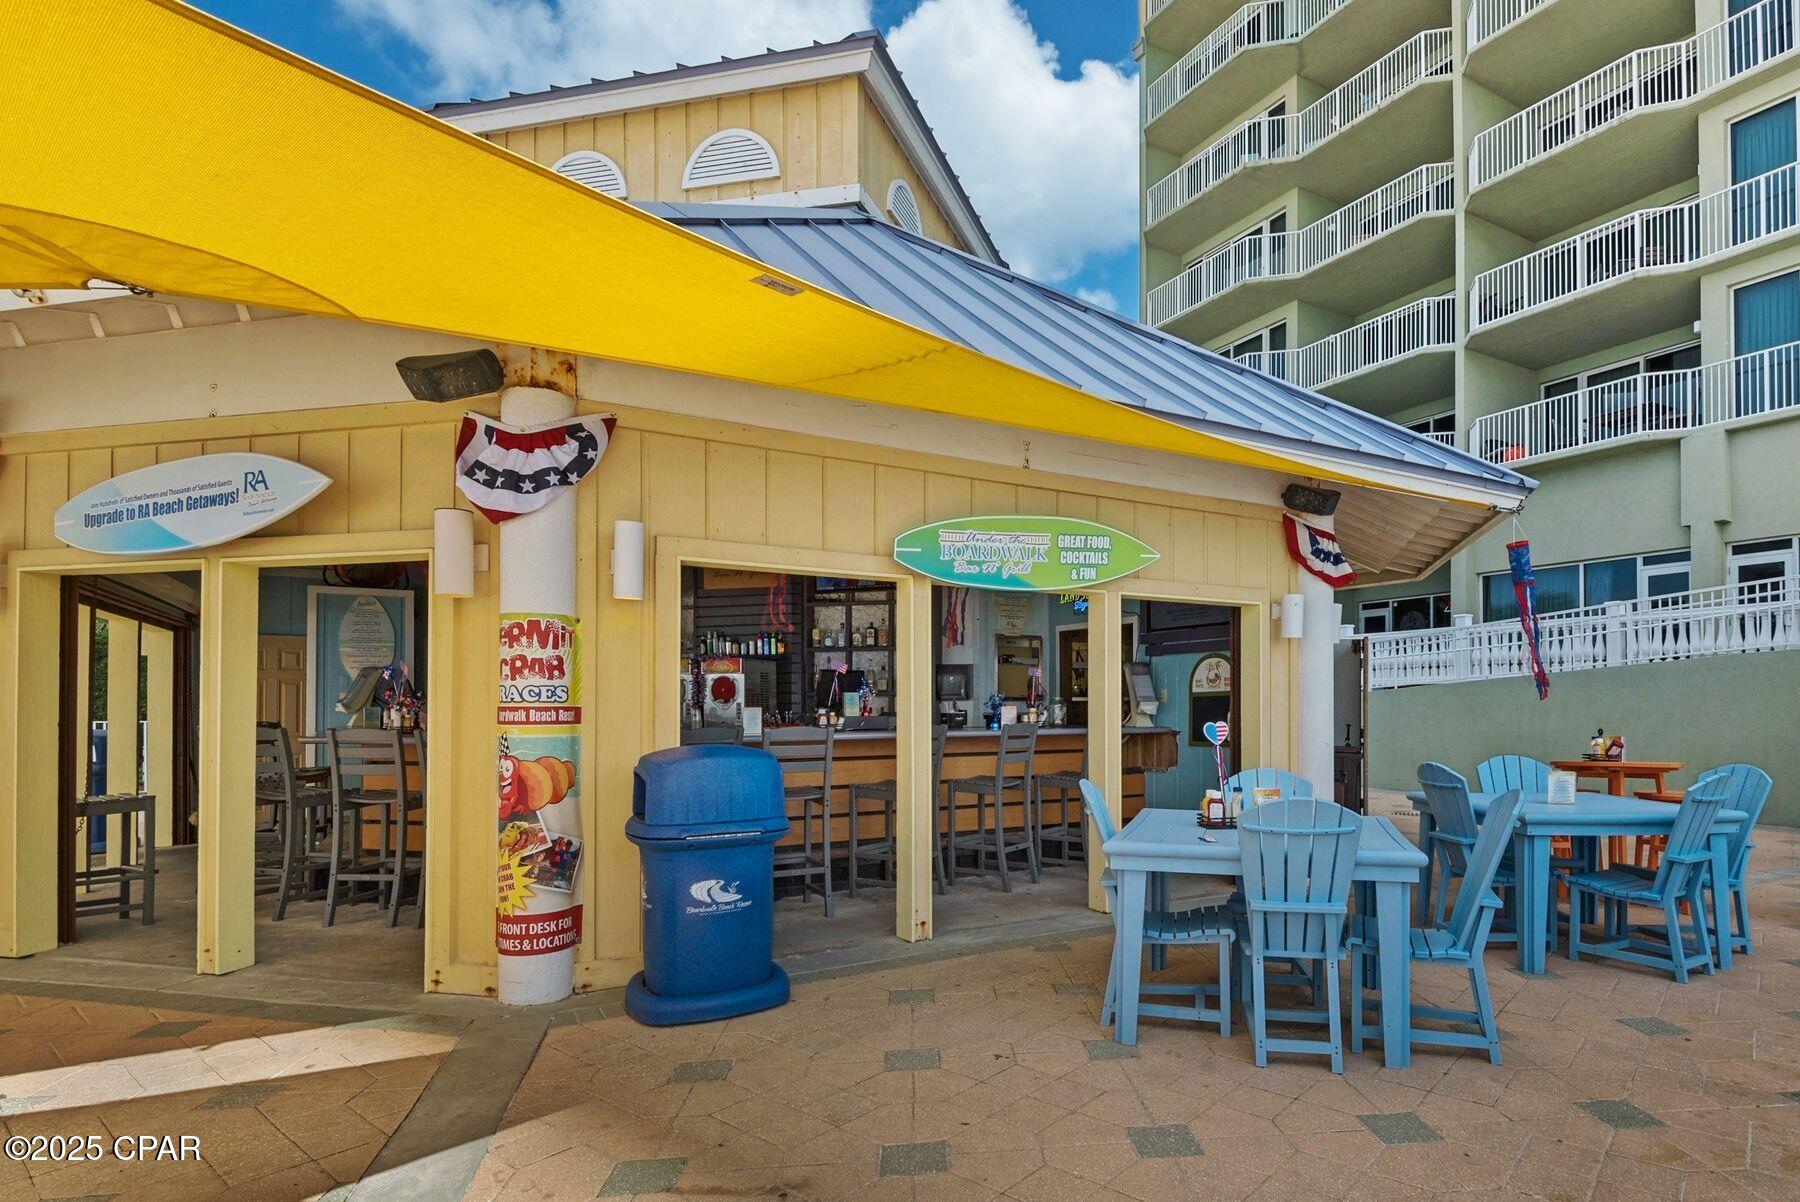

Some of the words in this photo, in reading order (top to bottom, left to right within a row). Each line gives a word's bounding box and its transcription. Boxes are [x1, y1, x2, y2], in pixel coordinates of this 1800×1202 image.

[243, 469, 270, 494] RA
[99, 499, 119, 507] Hundreds
[124, 493, 143, 503] Satisfied
[143, 492, 159, 500] Owners
[159, 489, 168, 497] and
[168, 486, 191, 496] Thousands
[191, 484, 198, 492] of
[197, 481, 217, 491] Satisfied
[217, 479, 233, 488] Guests
[84, 508, 124, 528] Upgrade
[126, 507, 136, 521] to
[137, 503, 150, 519] RA
[152, 497, 183, 517] Beach
[186, 487, 240, 511] Getaways!
[964, 530, 1005, 544] Under
[1007, 531, 1027, 544] the
[1057, 535, 1086, 549] GREAT
[1087, 535, 1112, 550] FOOD,
[940, 544, 1048, 562] BOARDWALK
[1060, 551, 1109, 565] COCKTAILS
[954, 561, 979, 573] Bar
[1002, 562, 1032, 579] Grill
[1071, 568, 1079, 580] &
[1079, 567, 1097, 580] FUN
[499, 684, 569, 703] RACES
[529, 709, 556, 722] Beach
[505, 883, 516, 892] THE
[718, 902, 735, 911] Beach
[500, 922, 528, 936] FRONT
[529, 920, 557, 935] DESK
[558, 916, 573, 930] FOR
[522, 939, 532, 951] &
[533, 928, 577, 950] LOCATIONS
